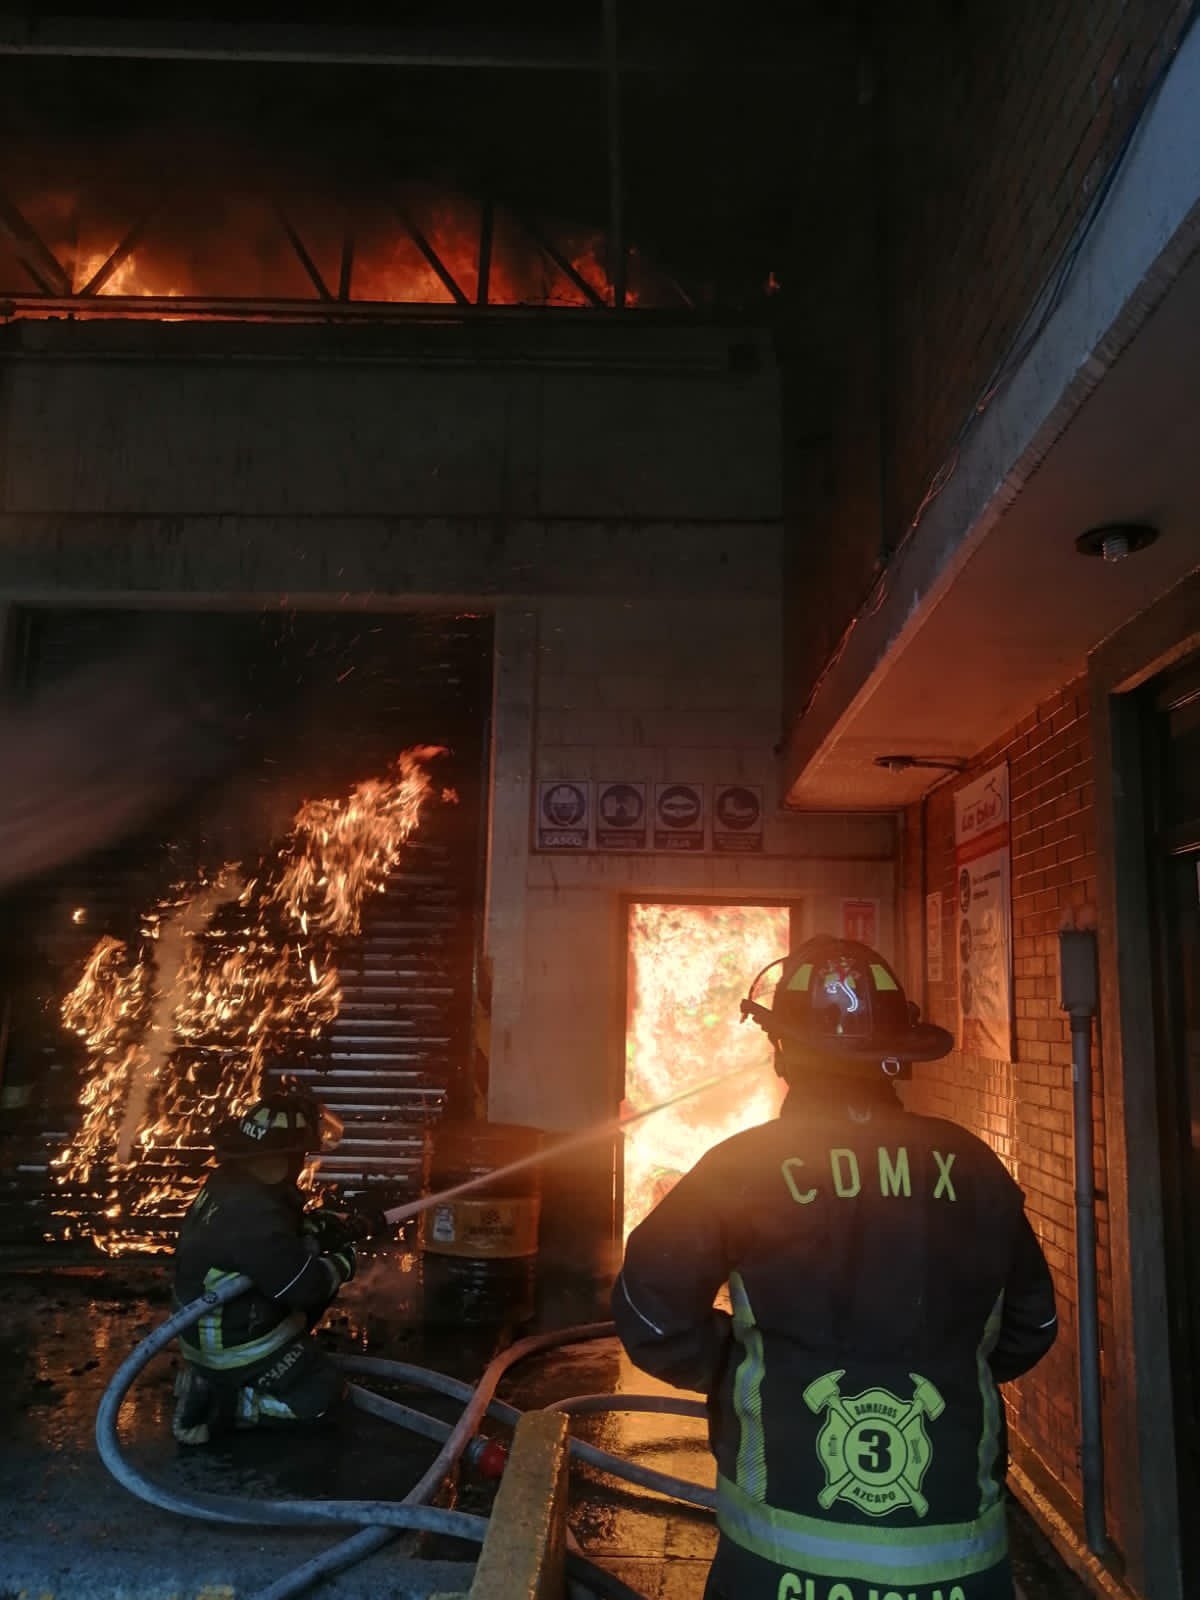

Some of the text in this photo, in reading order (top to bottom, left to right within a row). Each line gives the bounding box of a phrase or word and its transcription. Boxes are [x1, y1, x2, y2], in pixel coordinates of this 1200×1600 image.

[544, 836, 582, 846] CASCO
[240, 1118, 267, 1141] RLY
[781, 1145, 958, 1204] CDMX
[854, 1402, 899, 1419] BOMBEROS
[858, 1428, 892, 1474] 3
[852, 1486, 897, 1504] AZCAPO
